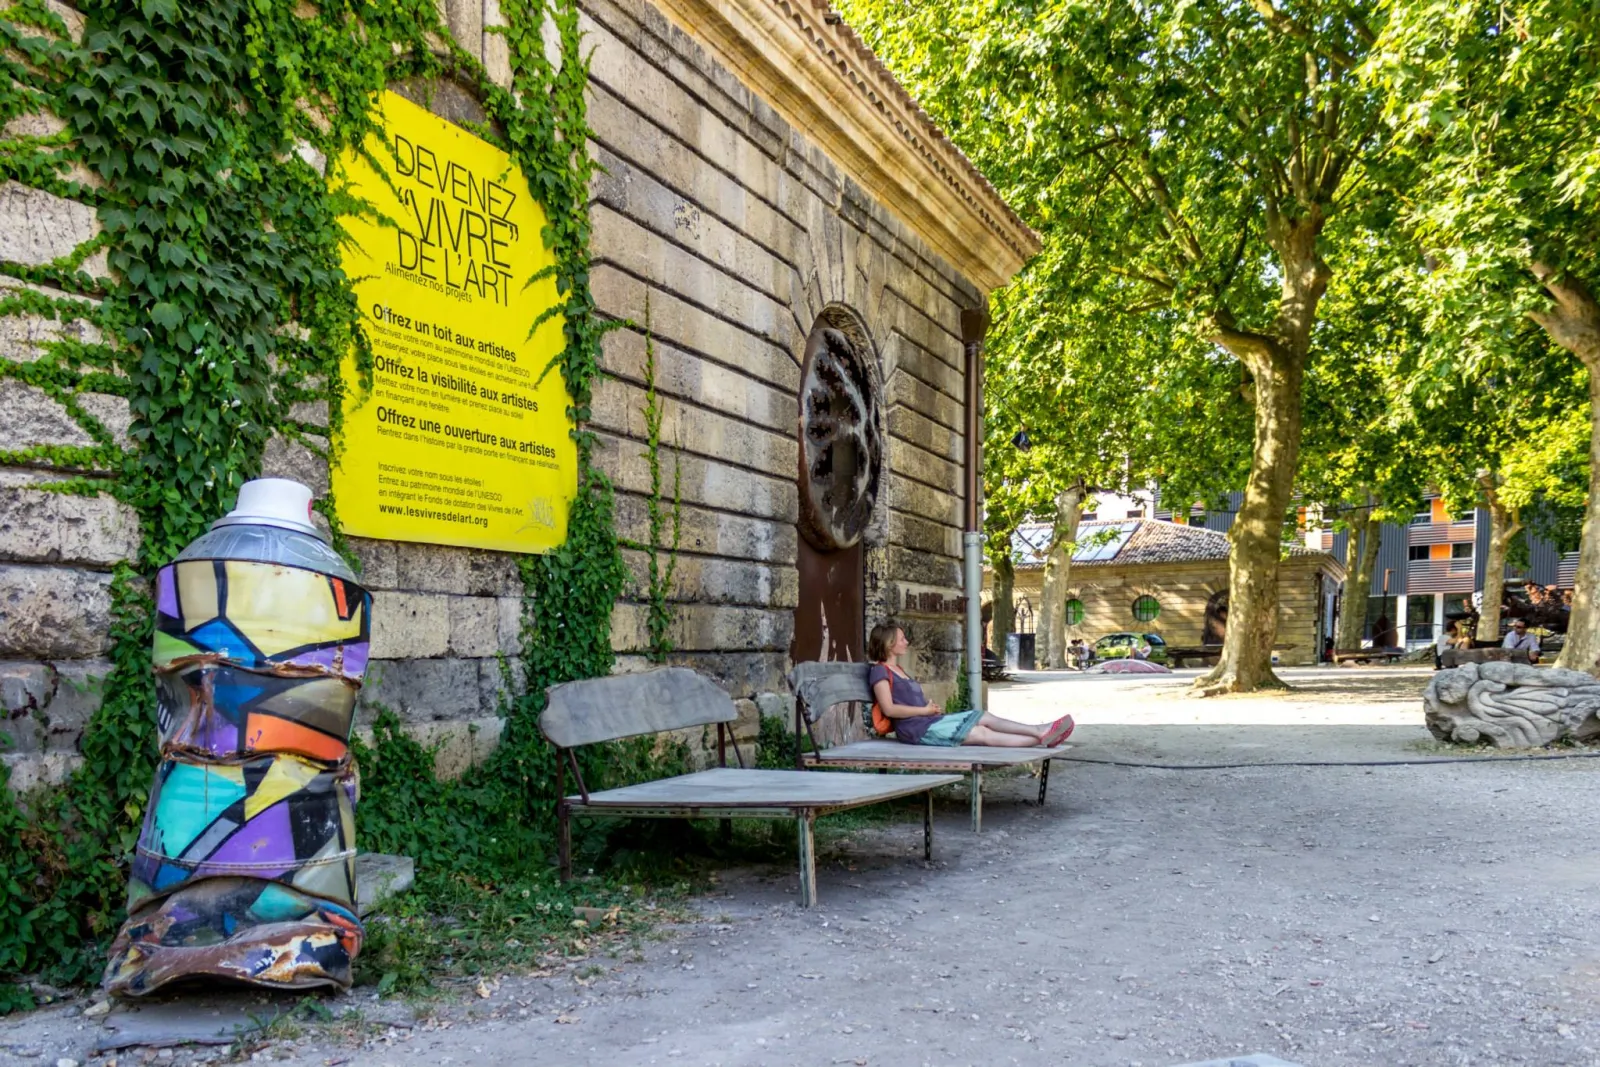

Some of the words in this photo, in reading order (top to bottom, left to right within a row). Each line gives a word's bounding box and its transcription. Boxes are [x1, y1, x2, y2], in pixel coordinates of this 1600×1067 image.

[395, 134, 517, 227] DEVENEZ
[398, 229, 437, 280] DE
[385, 261, 427, 287] Alimentez
[430, 280, 444, 292] nos
[446, 286, 472, 303] projets
[373, 304, 412, 330] Offrez
[415, 320, 430, 335] un
[433, 324, 452, 342] toit
[456, 334, 475, 349] aux
[478, 341, 516, 362] artistes
[403, 333, 419, 344] votre
[420, 340, 434, 348] nom
[444, 346, 474, 360] patrimoine
[375, 355, 414, 380] Offrez
[418, 366, 428, 383] la
[431, 370, 477, 396] visibilité
[480, 387, 499, 402] aux
[502, 393, 538, 412] artistes
[375, 374, 398, 388] Mettez
[399, 382, 416, 393] votre
[416, 386, 430, 396] nom
[376, 390, 384, 398] en
[376, 425, 402, 439] Rentrez
[404, 432, 419, 442] dans
[464, 444, 482, 455] grande
[377, 406, 416, 428] Offrez
[419, 418, 441, 434] une
[444, 424, 497, 446] ouverture
[500, 436, 517, 450] aux
[520, 440, 556, 458] artistes
[378, 461, 406, 474] Inscrivez
[408, 468, 424, 478] votre
[425, 472, 438, 480] nom
[440, 473, 454, 482] sous
[464, 476, 481, 486] étoiles
[378, 474, 400, 486] Entrez
[400, 480, 408, 488] au
[410, 480, 442, 493] patrimoine
[442, 484, 466, 496] mondial
[466, 488, 474, 498] de
[378, 489, 387, 497] en
[388, 488, 416, 502] intégrant
[418, 493, 423, 502] le
[424, 494, 442, 504] Fonds
[444, 498, 452, 506] de
[452, 498, 476, 510] dotation
[477, 502, 486, 511] des
[488, 504, 504, 514] Vivres
[504, 506, 511, 515] de
[379, 504, 488, 528] www.lesvivresdelart.org
